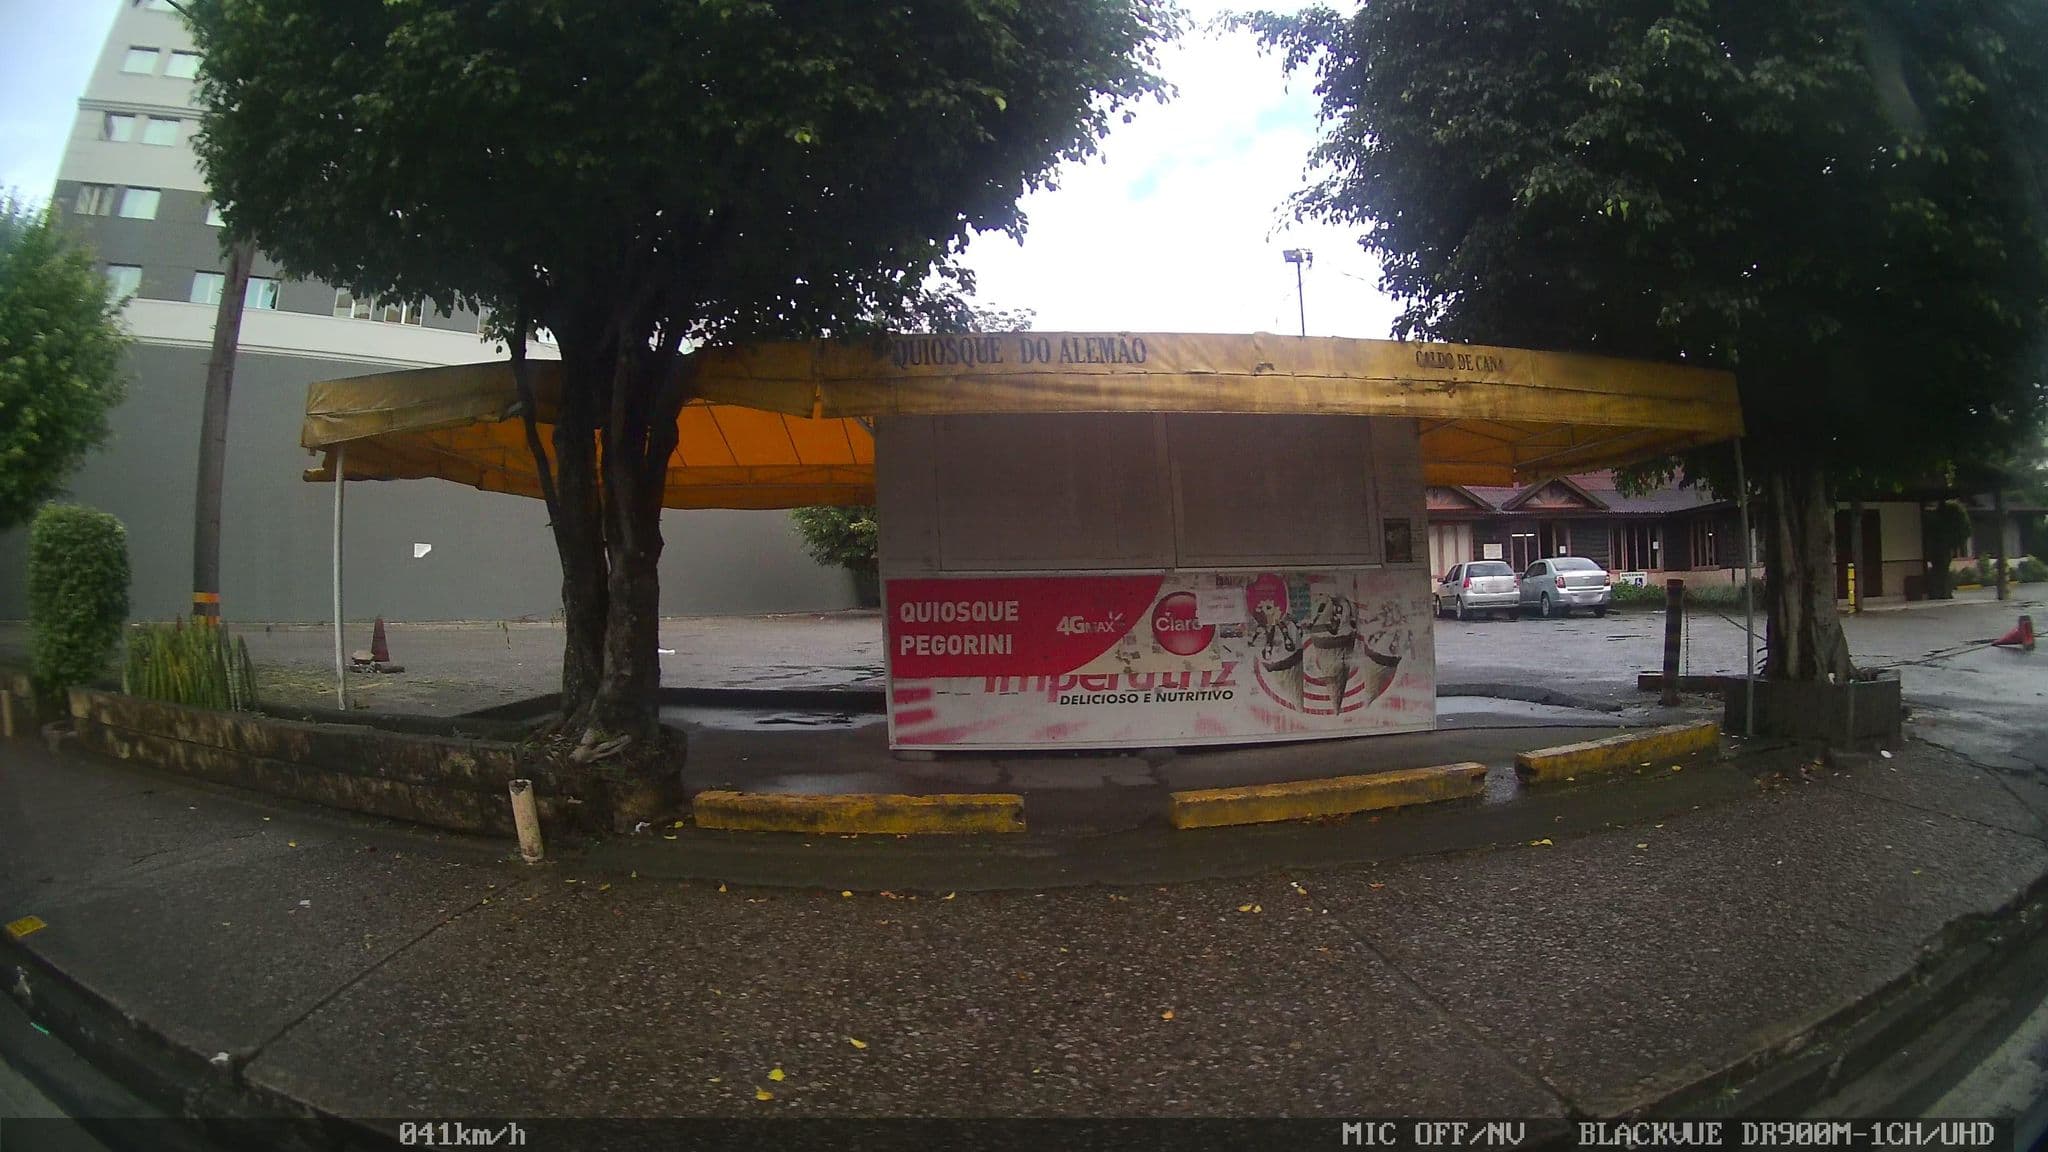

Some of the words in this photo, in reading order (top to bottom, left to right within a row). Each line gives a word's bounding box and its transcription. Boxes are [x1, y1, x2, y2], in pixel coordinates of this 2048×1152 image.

[893, 336, 1004, 369] QUIOSQUE
[1021, 337, 1050, 364] DO
[1058, 333, 1148, 364] ALEMÃO
[1457, 353, 1474, 371] DE
[900, 601, 1019, 623] QUIOSQUE
[900, 634, 1013, 656] PEGORINI
[1059, 693, 1139, 705] DELICIOSO
[1143, 693, 1151, 703] E
[1156, 690, 1234, 703] NUTRITIVO
